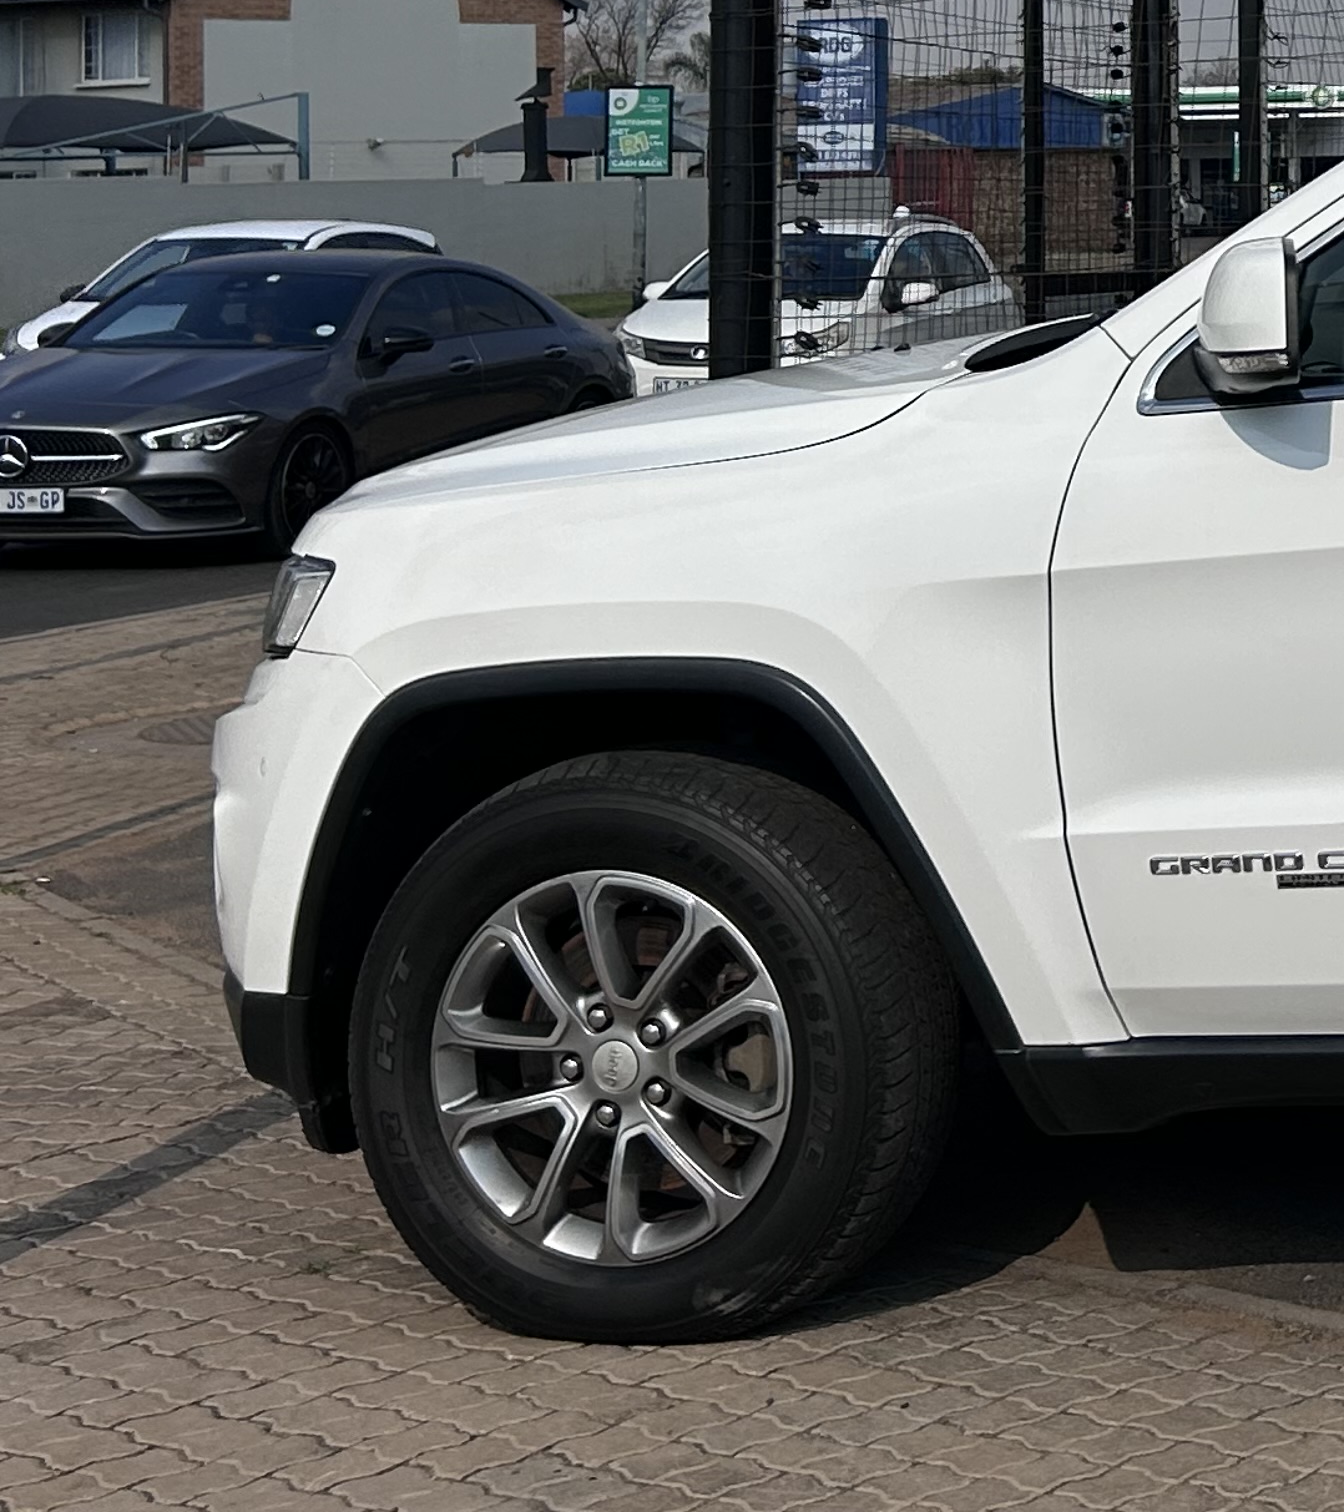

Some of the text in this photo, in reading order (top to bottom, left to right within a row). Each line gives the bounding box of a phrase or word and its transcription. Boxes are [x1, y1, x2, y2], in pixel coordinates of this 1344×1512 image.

[611, 159, 637, 167] CASH
[7, 491, 60, 509] JS GP
[1149, 849, 1304, 875] GRAND
[376, 945, 412, 1074] H/T
